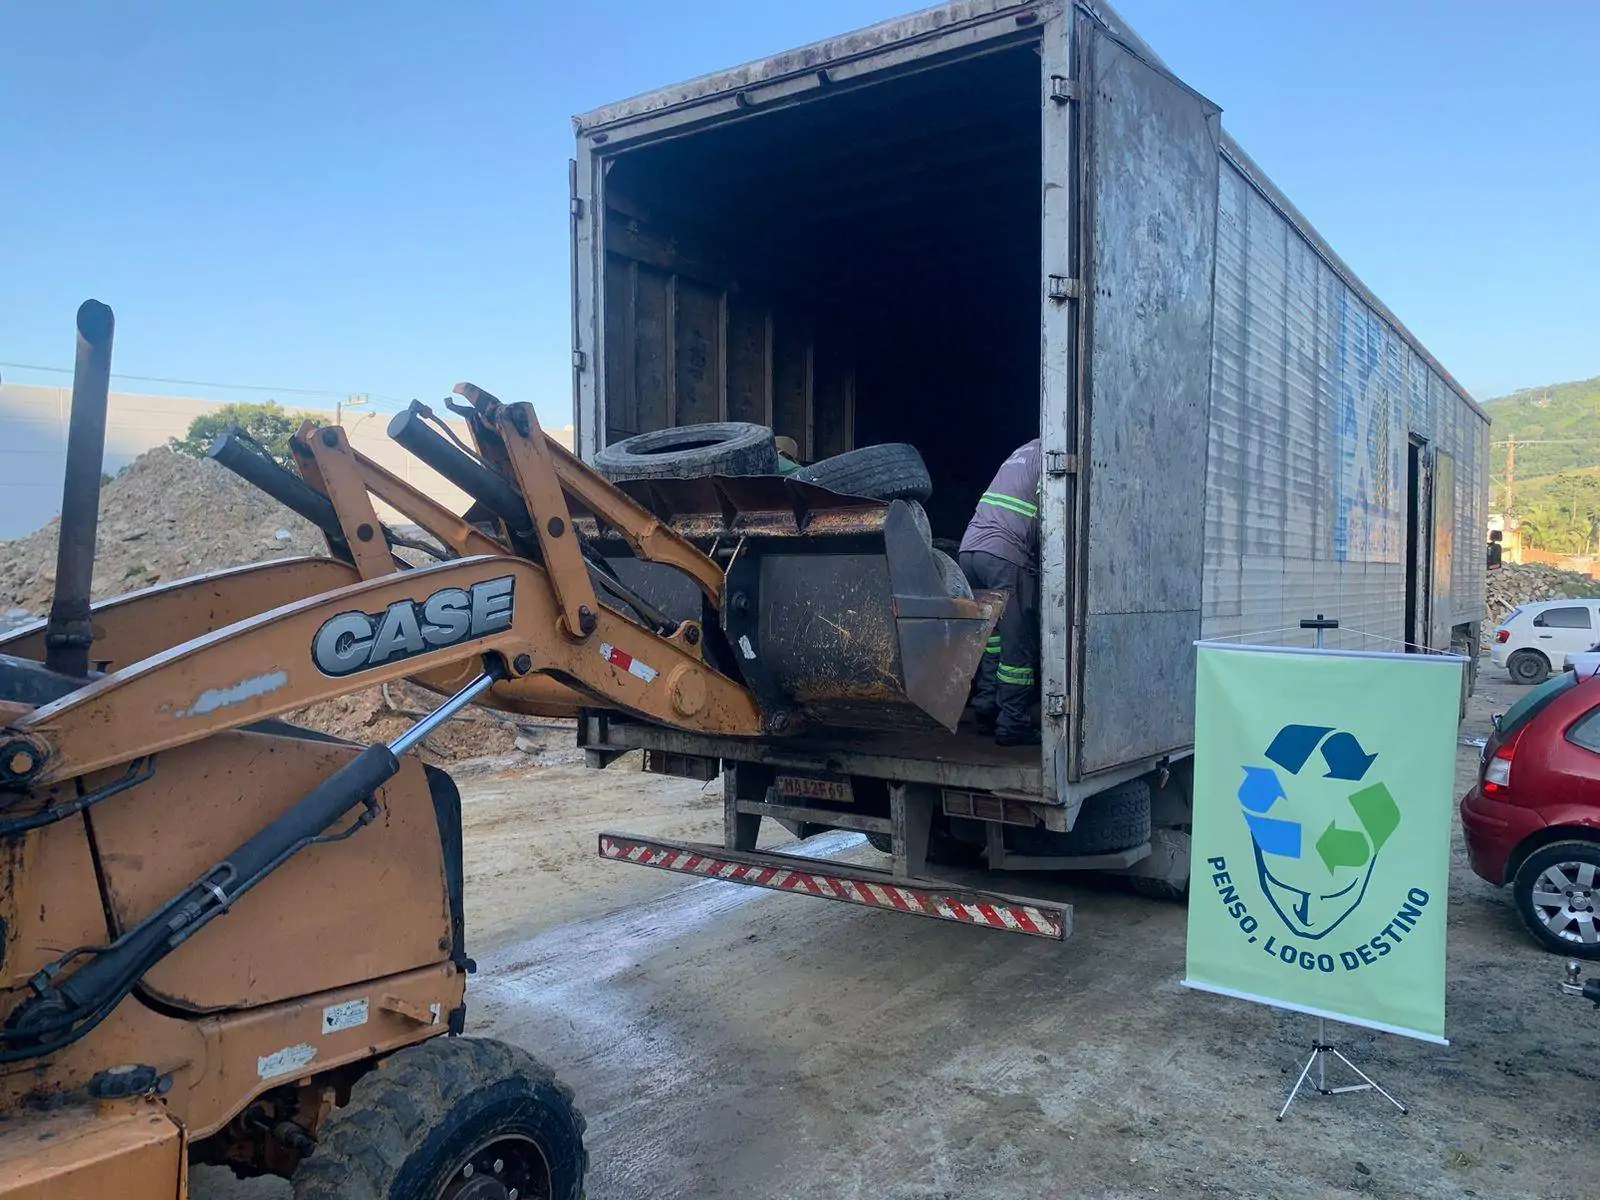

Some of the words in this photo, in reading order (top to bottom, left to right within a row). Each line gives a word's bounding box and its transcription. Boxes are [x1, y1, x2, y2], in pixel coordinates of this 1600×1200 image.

[312, 575, 514, 676] CASE
[1207, 856, 1259, 944] PENSO,
[1263, 936, 1335, 973] LOGO
[1339, 887, 1430, 971] DESTINO
